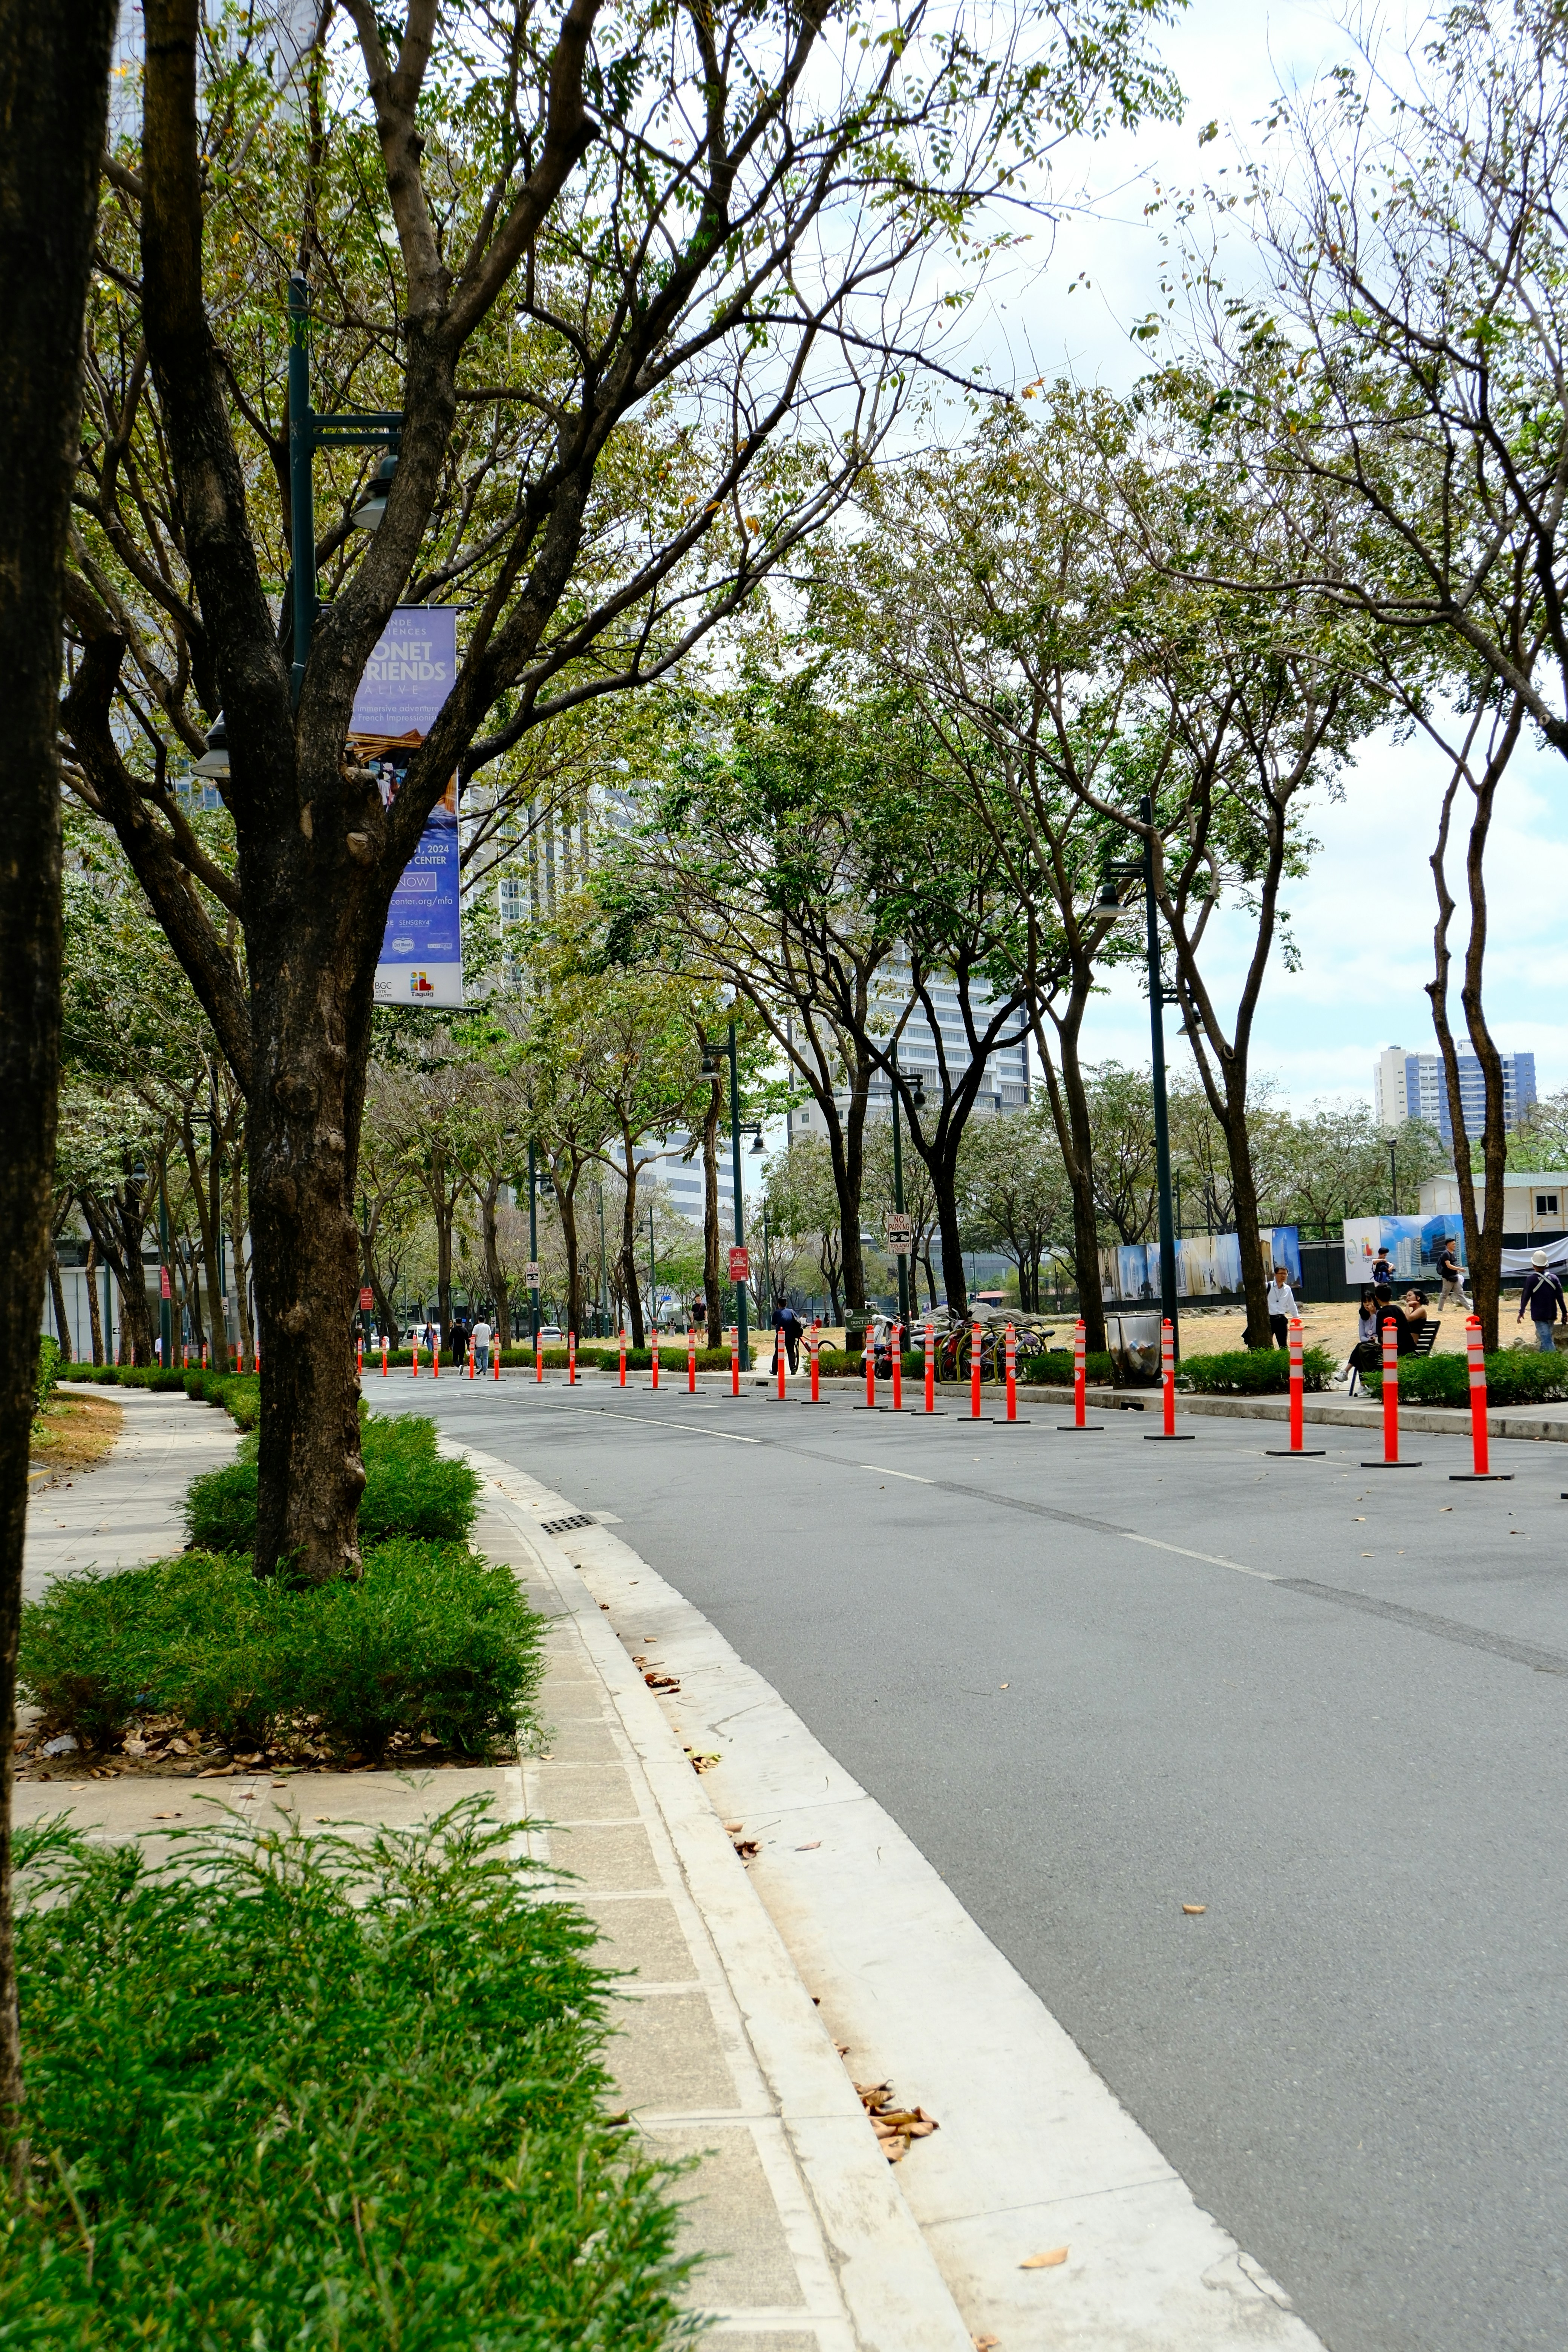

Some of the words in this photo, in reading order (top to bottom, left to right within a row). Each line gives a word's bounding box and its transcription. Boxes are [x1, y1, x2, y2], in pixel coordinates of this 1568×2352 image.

[370, 642, 432, 661] ONET
[363, 662, 446, 681] RIENDS
[364, 685, 418, 694] ALIVE
[427, 845, 449, 853] 2024
[414, 856, 446, 864] CENTER
[397, 877, 429, 887] NOW
